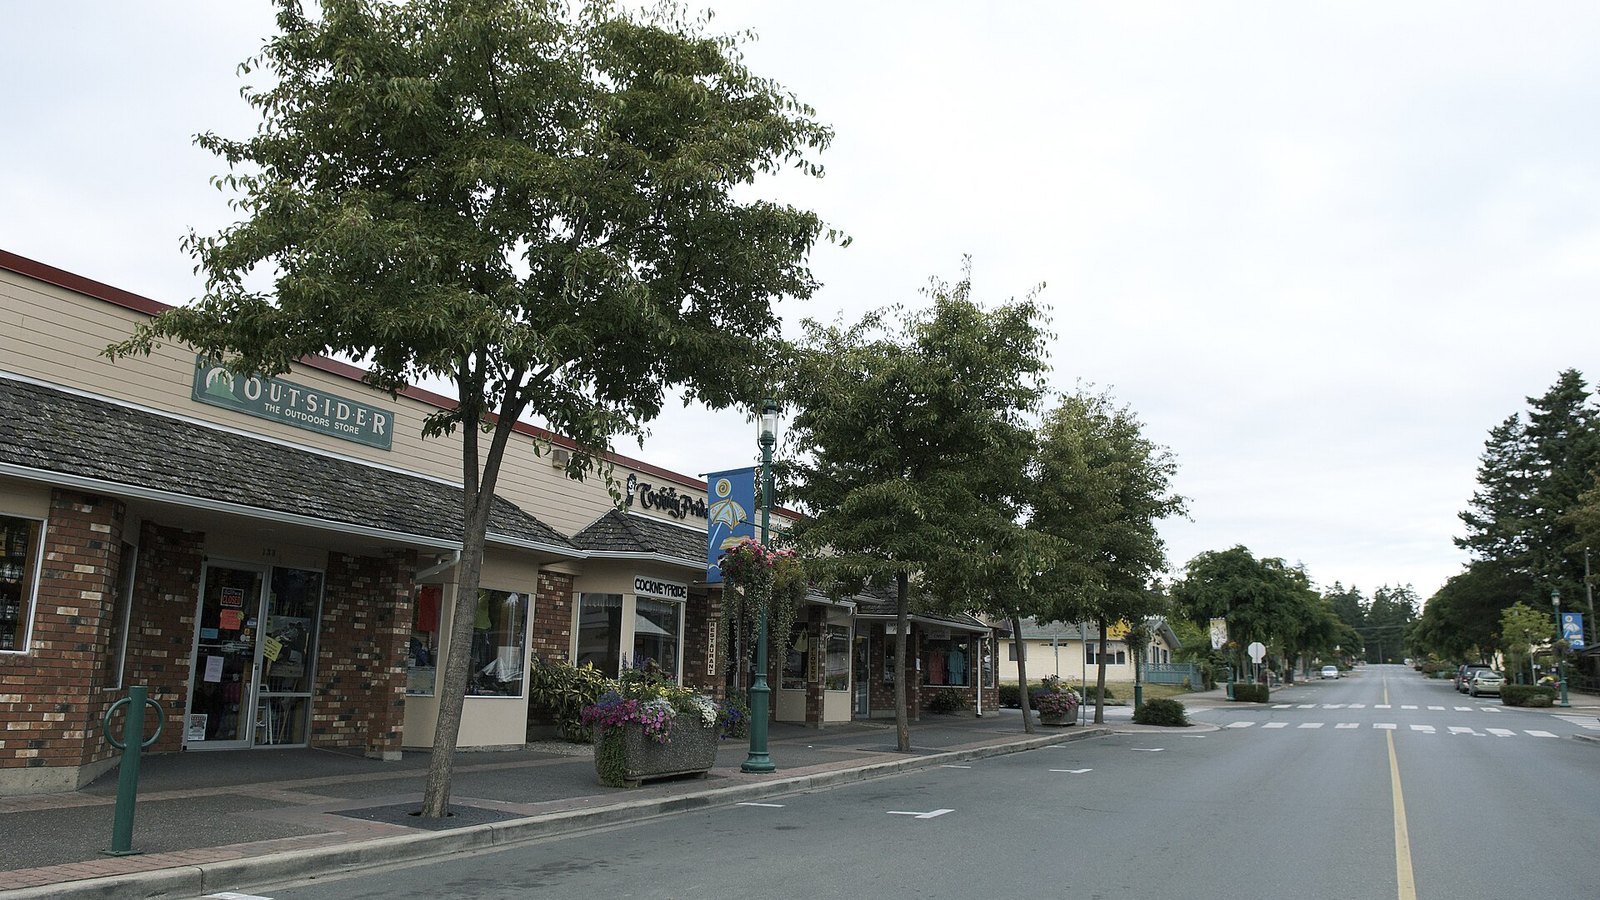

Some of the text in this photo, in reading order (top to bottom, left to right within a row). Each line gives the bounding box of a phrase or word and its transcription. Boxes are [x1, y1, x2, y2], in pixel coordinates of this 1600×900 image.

[264, 402, 360, 435] THE OUTDOORS STORE
[707, 621, 716, 674] RESTAURANT
